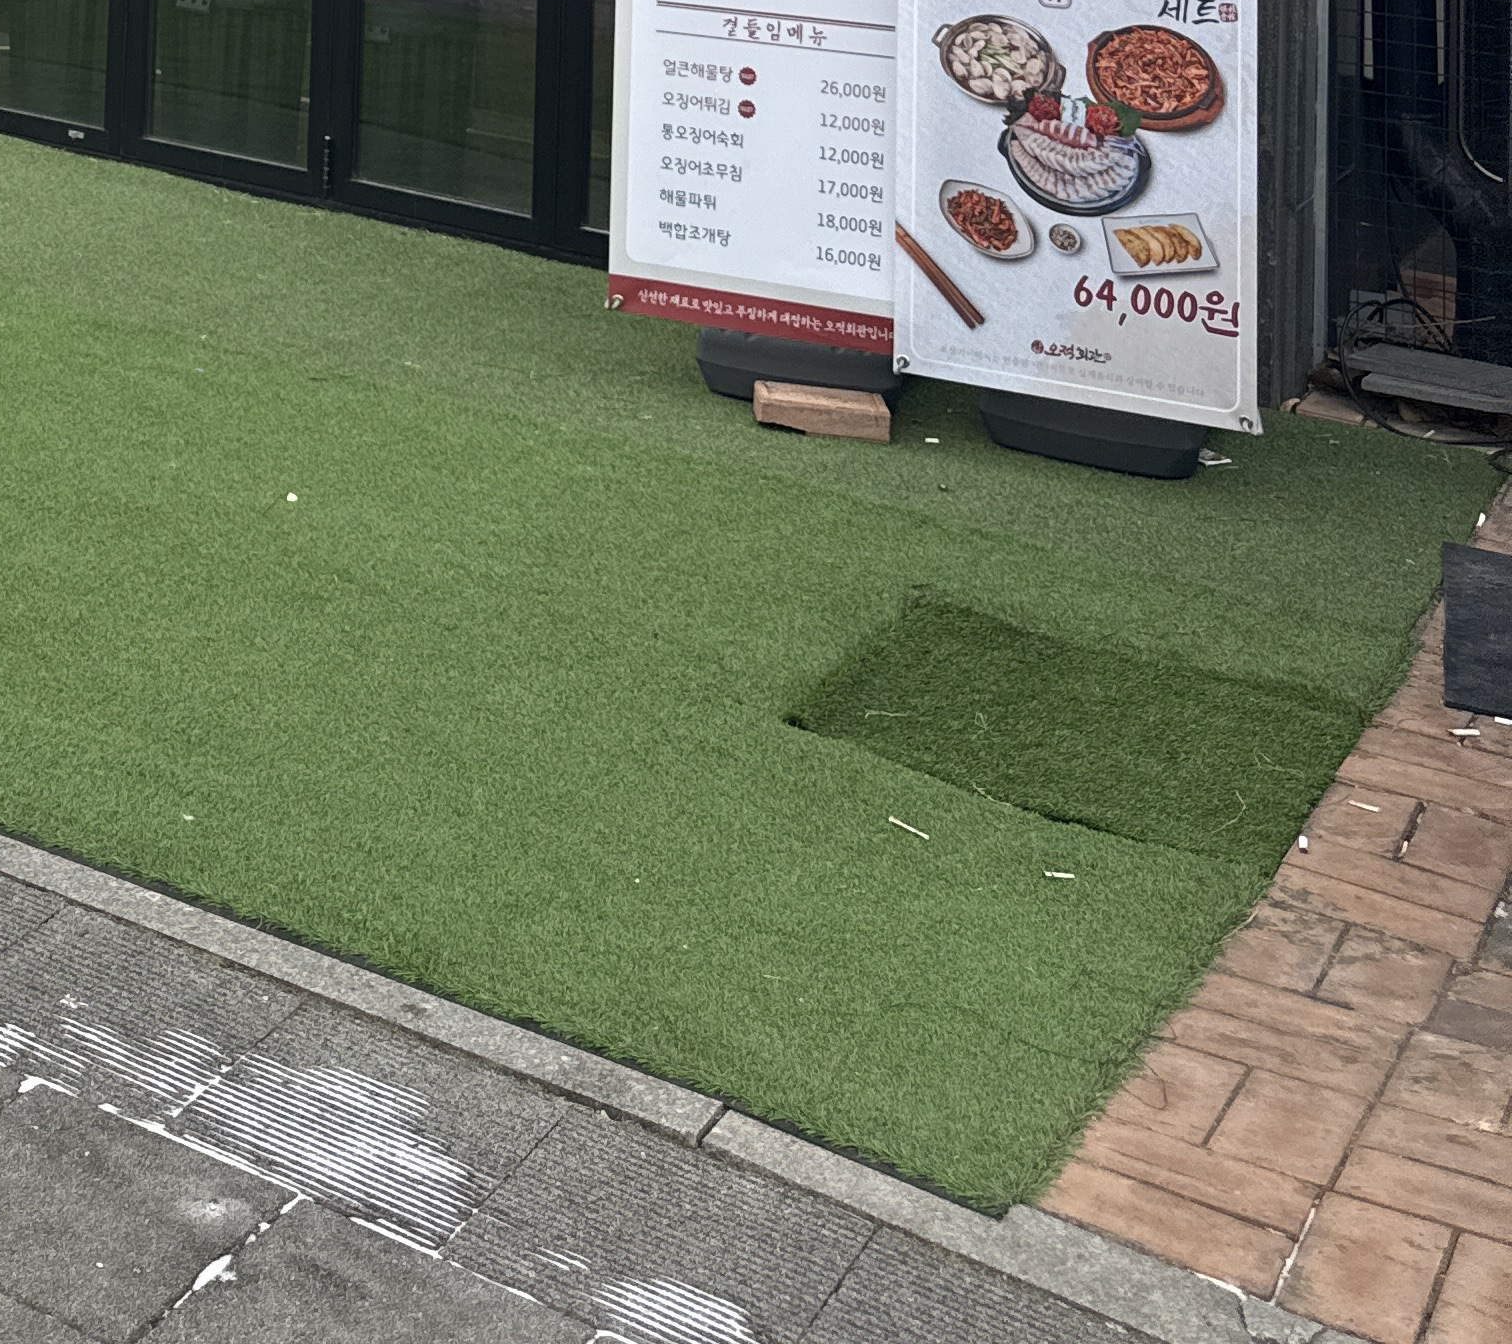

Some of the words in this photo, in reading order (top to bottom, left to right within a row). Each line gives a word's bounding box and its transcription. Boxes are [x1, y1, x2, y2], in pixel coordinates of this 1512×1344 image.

[662, 58, 733, 83] 얼큰해물탕
[820, 79, 886, 102] 26,000원
[662, 91, 731, 116] 오징어튀김
[820, 113, 885, 136] 12,000원
[661, 123, 744, 148] 통오징어숙회
[819, 145, 884, 169] 12,000원
[659, 156, 743, 182] 오징어초무침
[818, 179, 884, 203] 17,000원
[658, 220, 731, 247] 백합조개탕
[816, 246, 882, 271] 16,000원
[817, 212, 883, 237] 18,000원
[638, 288, 669, 307] 신선한
[1074, 275, 1240, 337] 64,000원
[1044, 343, 1106, 363] 오적회관
